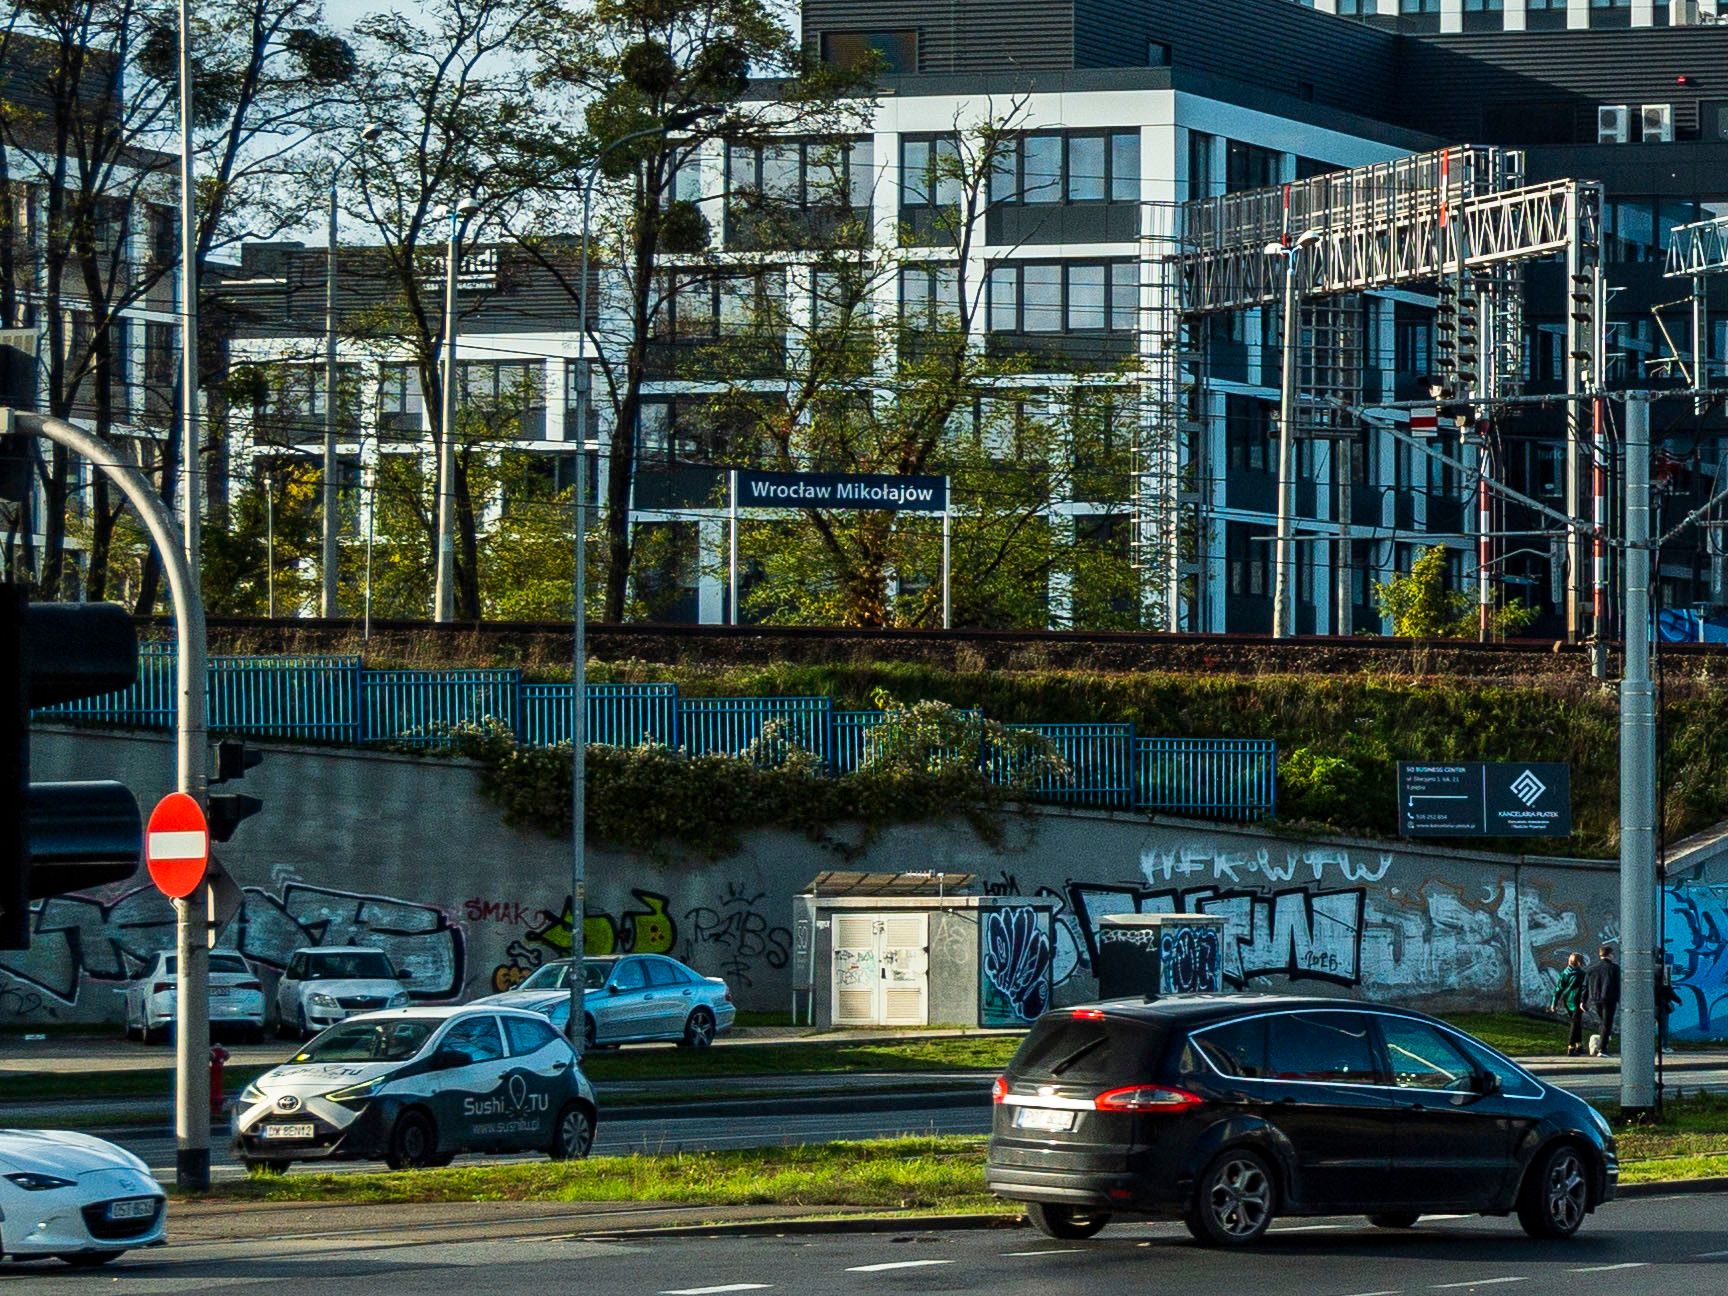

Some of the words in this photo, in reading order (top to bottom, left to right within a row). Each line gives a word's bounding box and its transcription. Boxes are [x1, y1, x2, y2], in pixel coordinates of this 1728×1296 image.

[751, 481, 831, 499] Wrocław
[837, 482, 934, 504] Mikołajów
[463, 1095, 505, 1116] Sushi
[528, 1093, 549, 1111] TU
